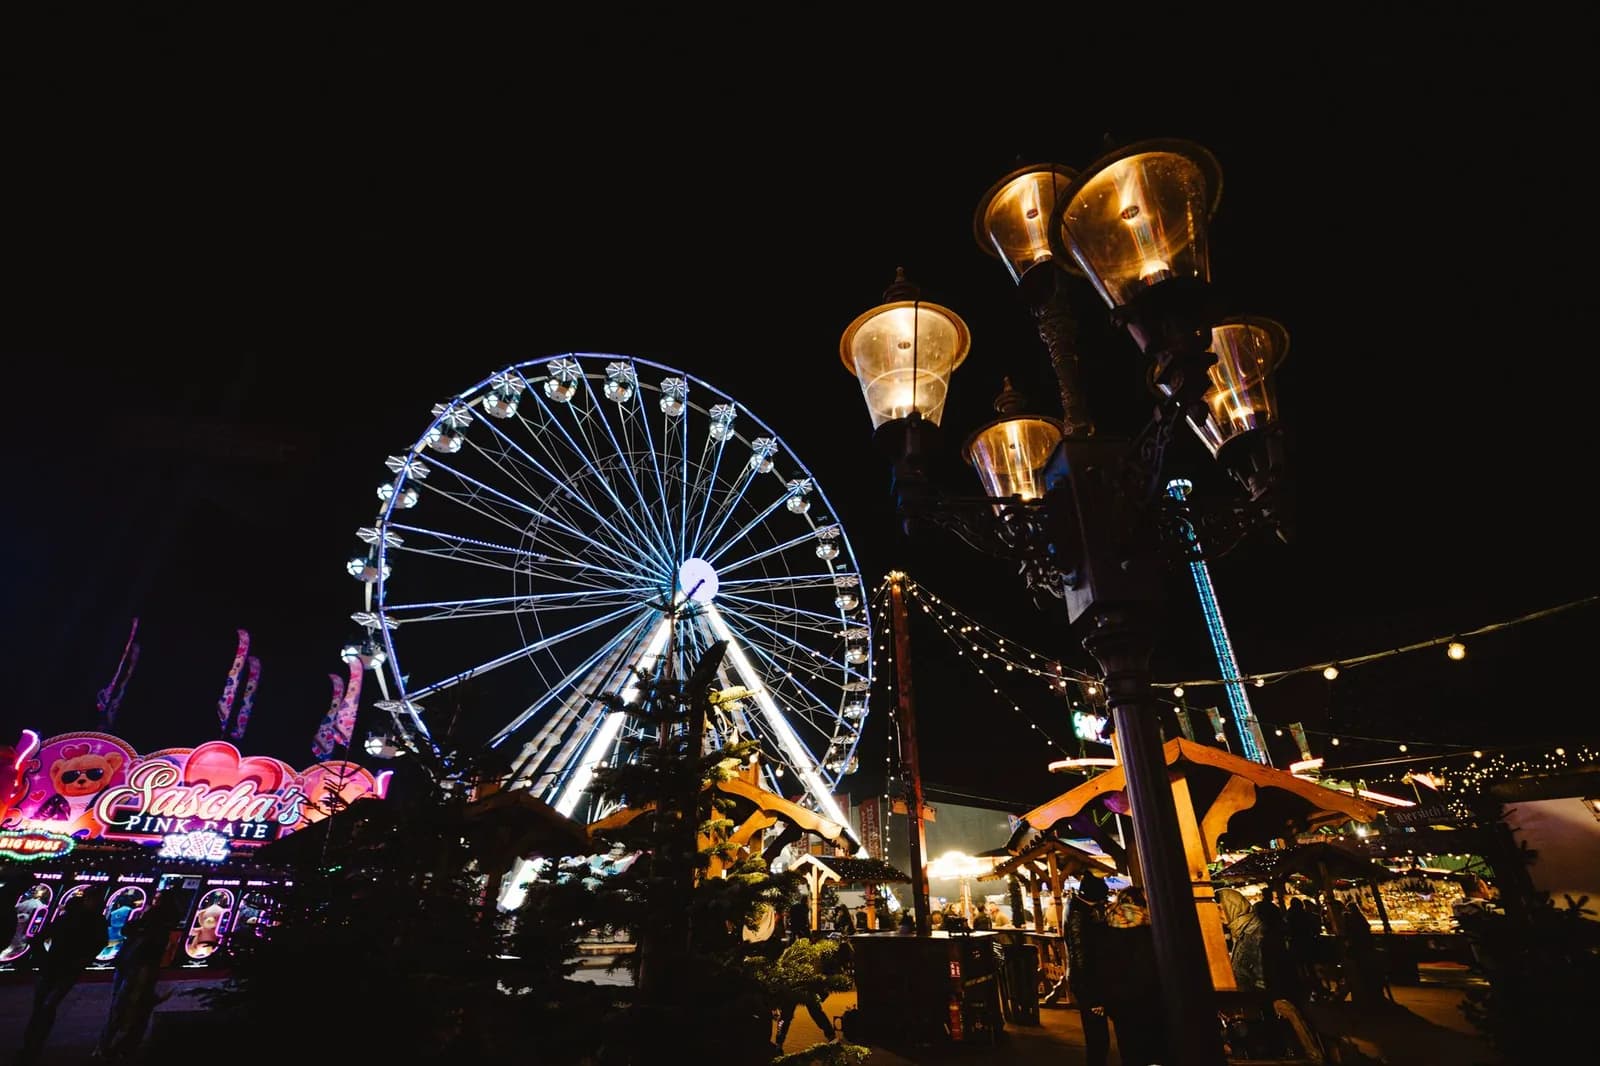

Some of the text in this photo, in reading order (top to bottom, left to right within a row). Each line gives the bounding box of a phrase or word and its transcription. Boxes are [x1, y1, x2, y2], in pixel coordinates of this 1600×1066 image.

[99, 761, 303, 825] Sascha's
[124, 815, 188, 834] PINK
[24, 839, 62, 852] HUGS
[158, 830, 232, 862] XXL
